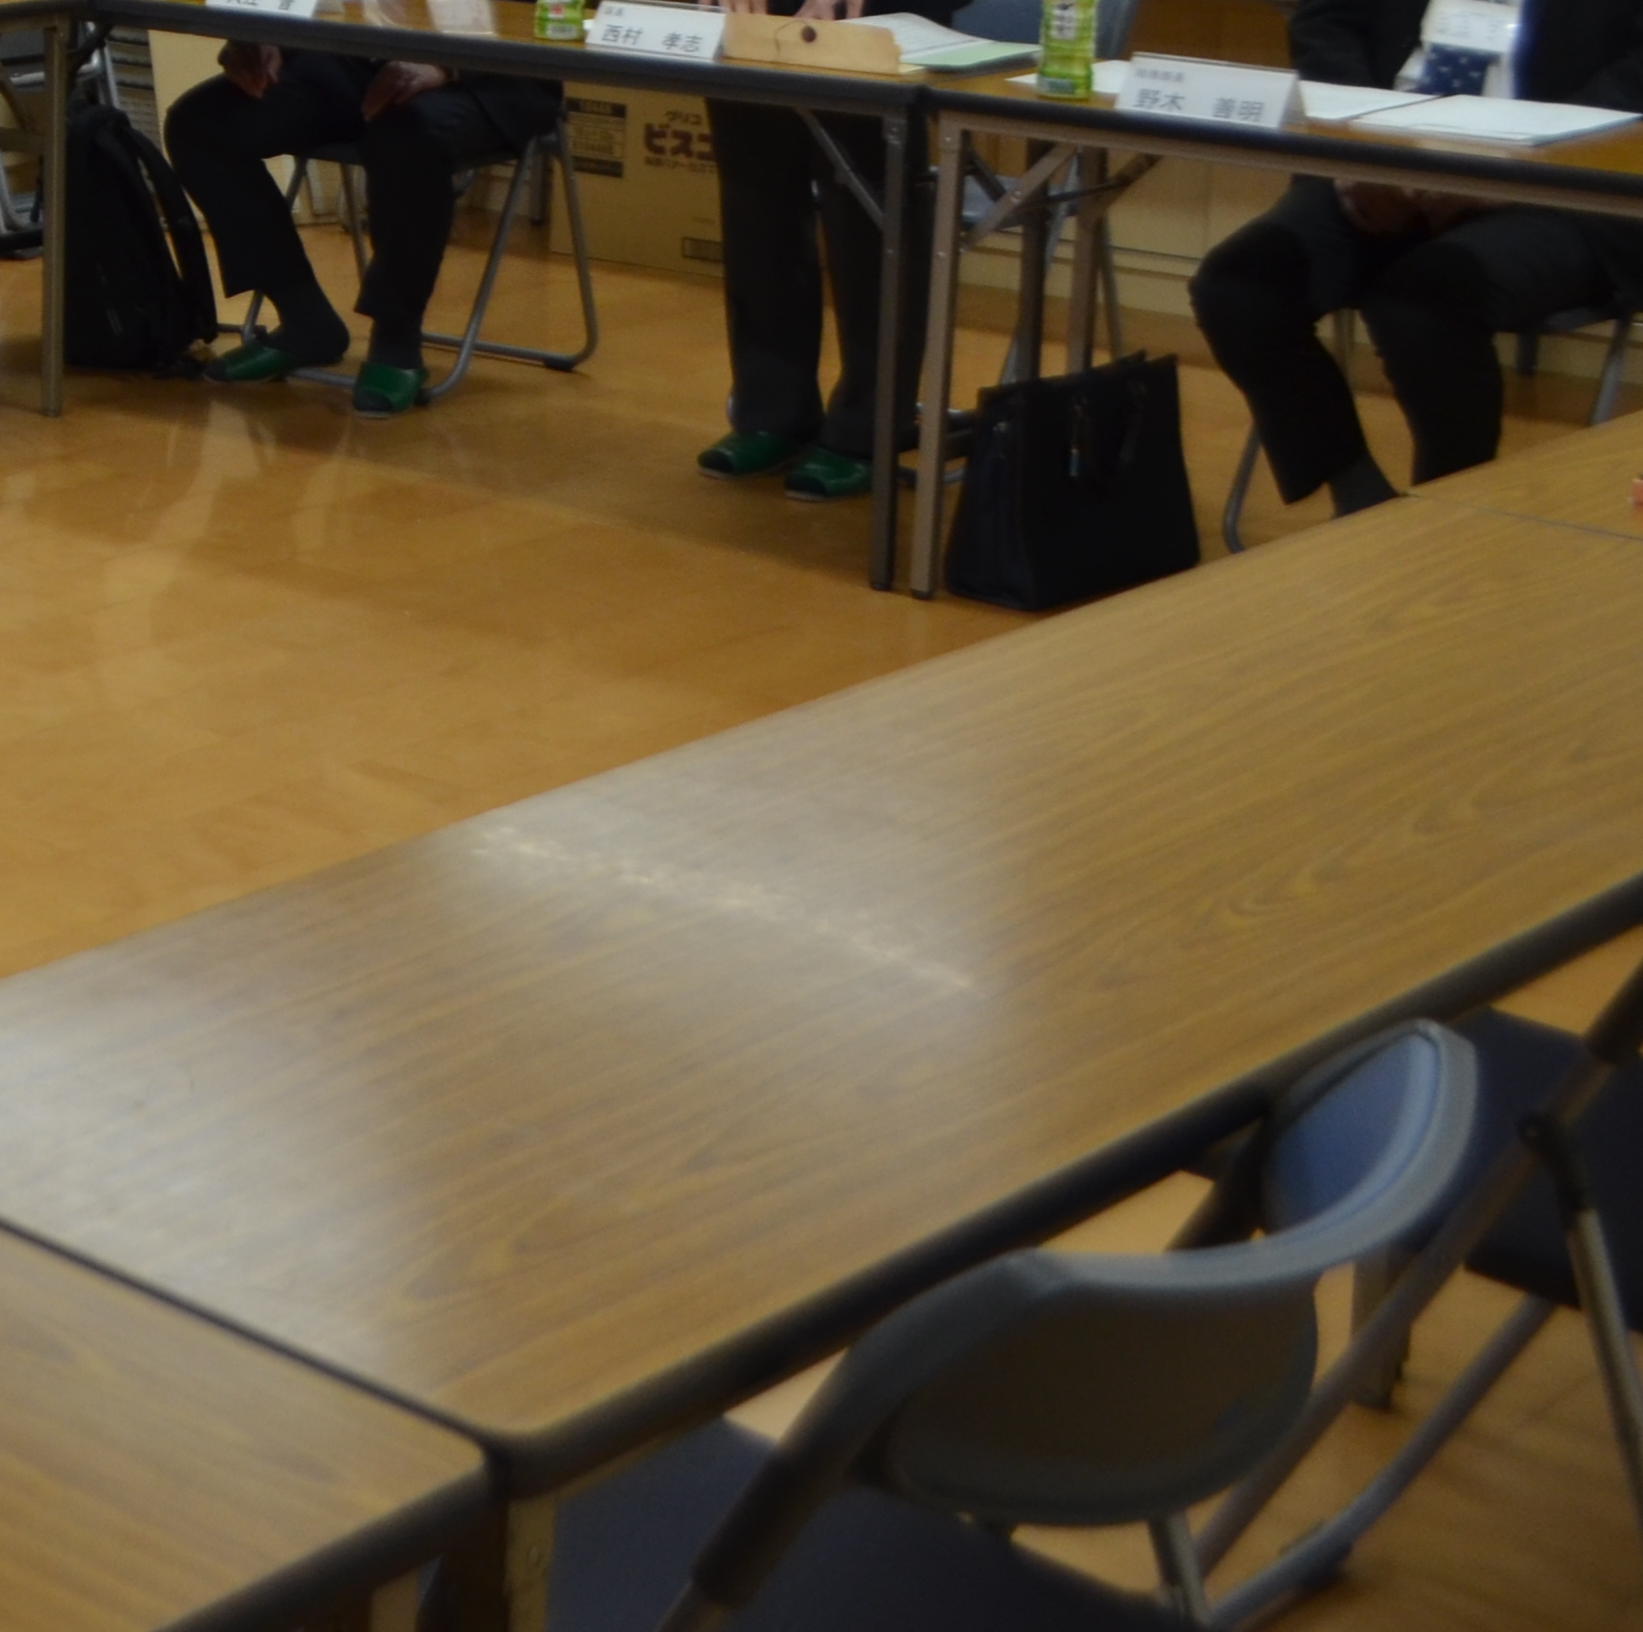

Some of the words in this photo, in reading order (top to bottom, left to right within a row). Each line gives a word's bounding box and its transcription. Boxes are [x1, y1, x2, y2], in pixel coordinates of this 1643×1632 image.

[600, 24, 643, 45] 西村
[660, 30, 704, 53] 孝志
[1131, 88, 1185, 114] 野木
[665, 109, 703, 126] グリコ
